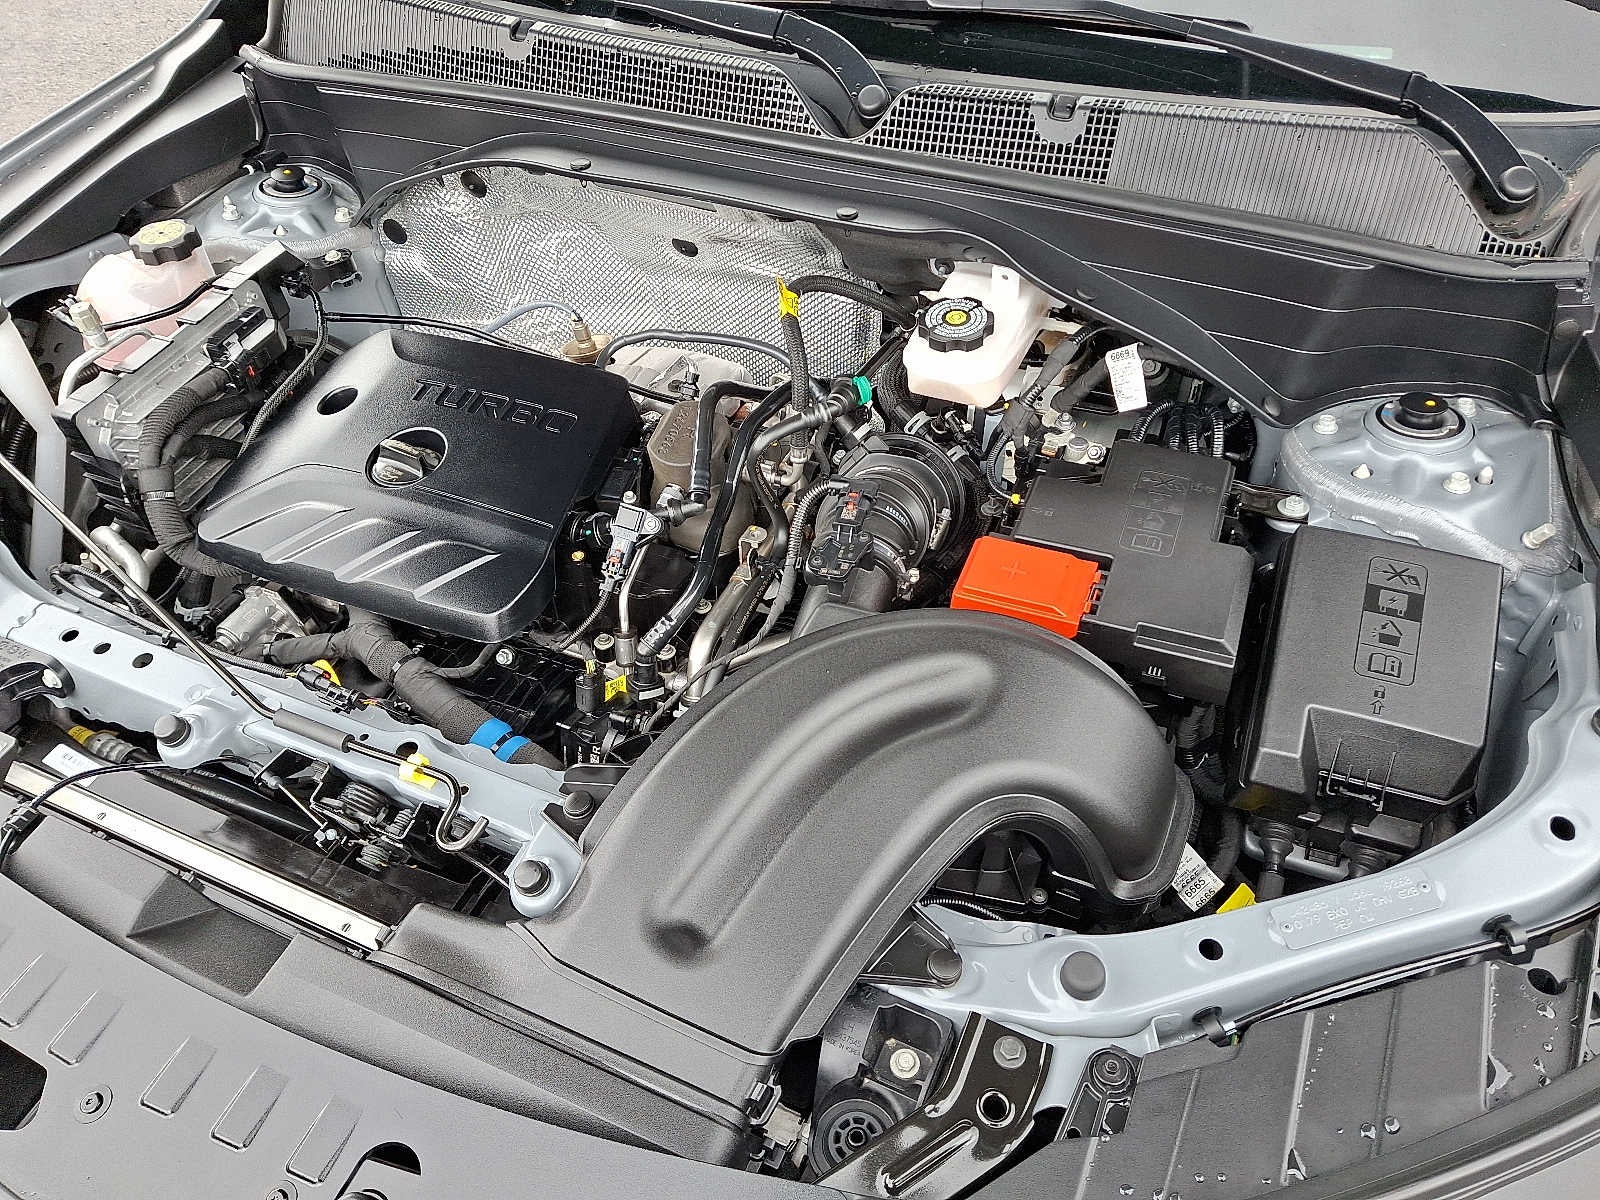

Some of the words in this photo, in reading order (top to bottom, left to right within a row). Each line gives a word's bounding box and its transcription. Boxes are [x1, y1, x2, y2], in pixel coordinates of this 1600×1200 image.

[412, 378, 578, 434] TURBO
[1184, 876, 1206, 898] 6665
[1195, 887, 1216, 908] 6665
